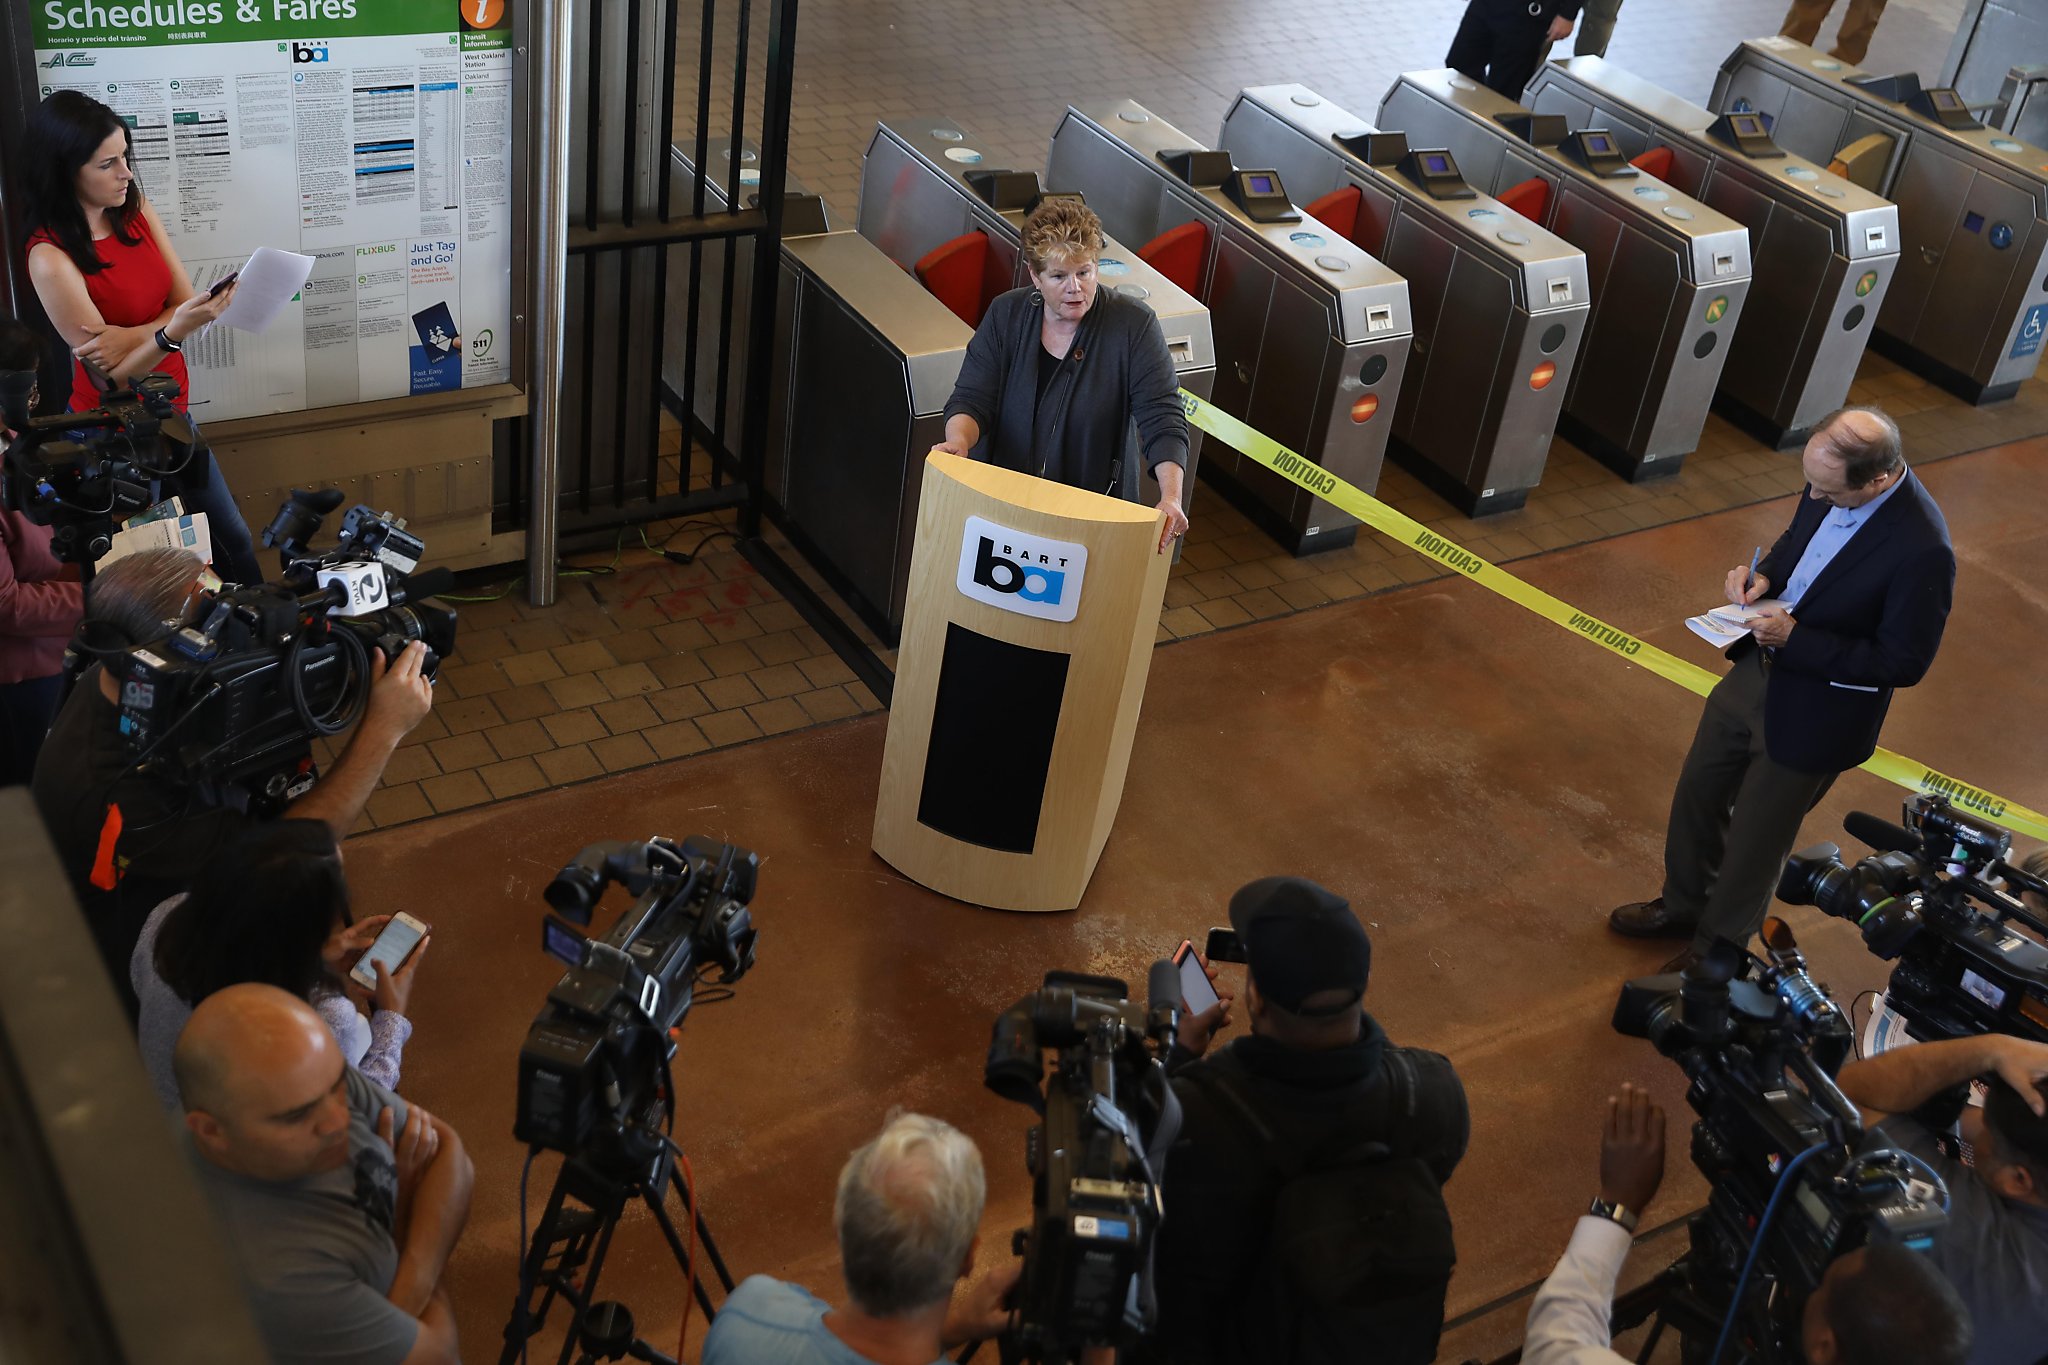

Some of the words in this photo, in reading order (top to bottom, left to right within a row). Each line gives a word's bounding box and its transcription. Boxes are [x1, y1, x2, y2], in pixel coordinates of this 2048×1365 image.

[44, 0, 223, 30] Schedules
[236, 0, 262, 22] &
[274, 0, 357, 21] Fares
[411, 243, 433, 252] Just
[436, 241, 456, 252] Tag
[411, 255, 432, 266] and
[435, 254, 453, 263] Go!
[473, 339, 487, 348] 511
[1003, 545, 1068, 567] BART
[974, 536, 1065, 605] ba
[352, 580, 360, 605] KTVU
[305, 656, 335, 671] Panasonic
